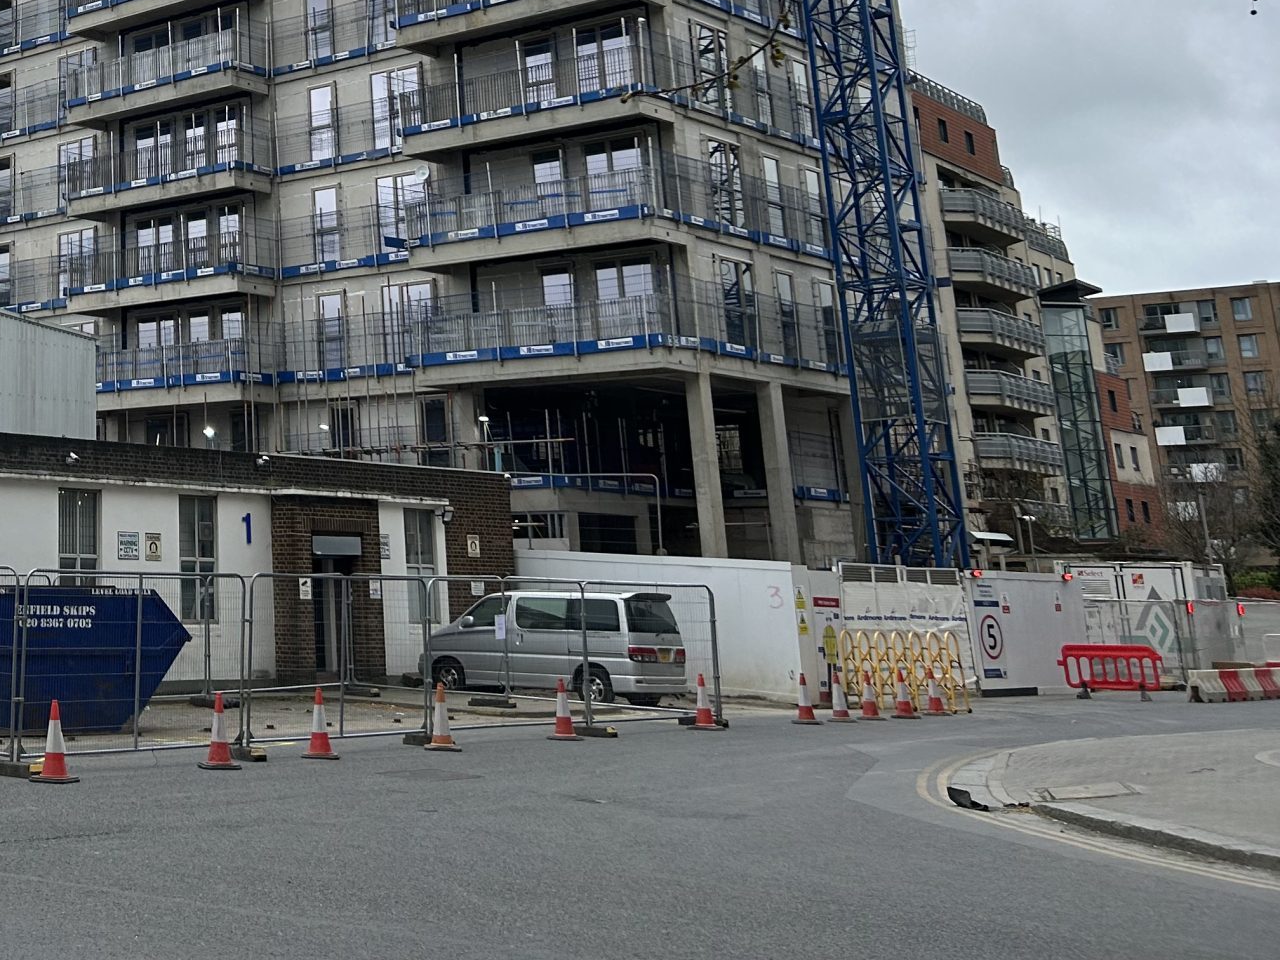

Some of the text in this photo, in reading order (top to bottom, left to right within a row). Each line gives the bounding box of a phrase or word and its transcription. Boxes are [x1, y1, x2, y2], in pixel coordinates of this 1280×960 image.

[241, 512, 252, 545] 1
[767, 586, 784, 609] 3
[63, 605, 96, 616] SKIPS
[40, 618, 64, 628] 8367
[67, 618, 92, 628] 0703
[986, 624, 997, 650] 5
